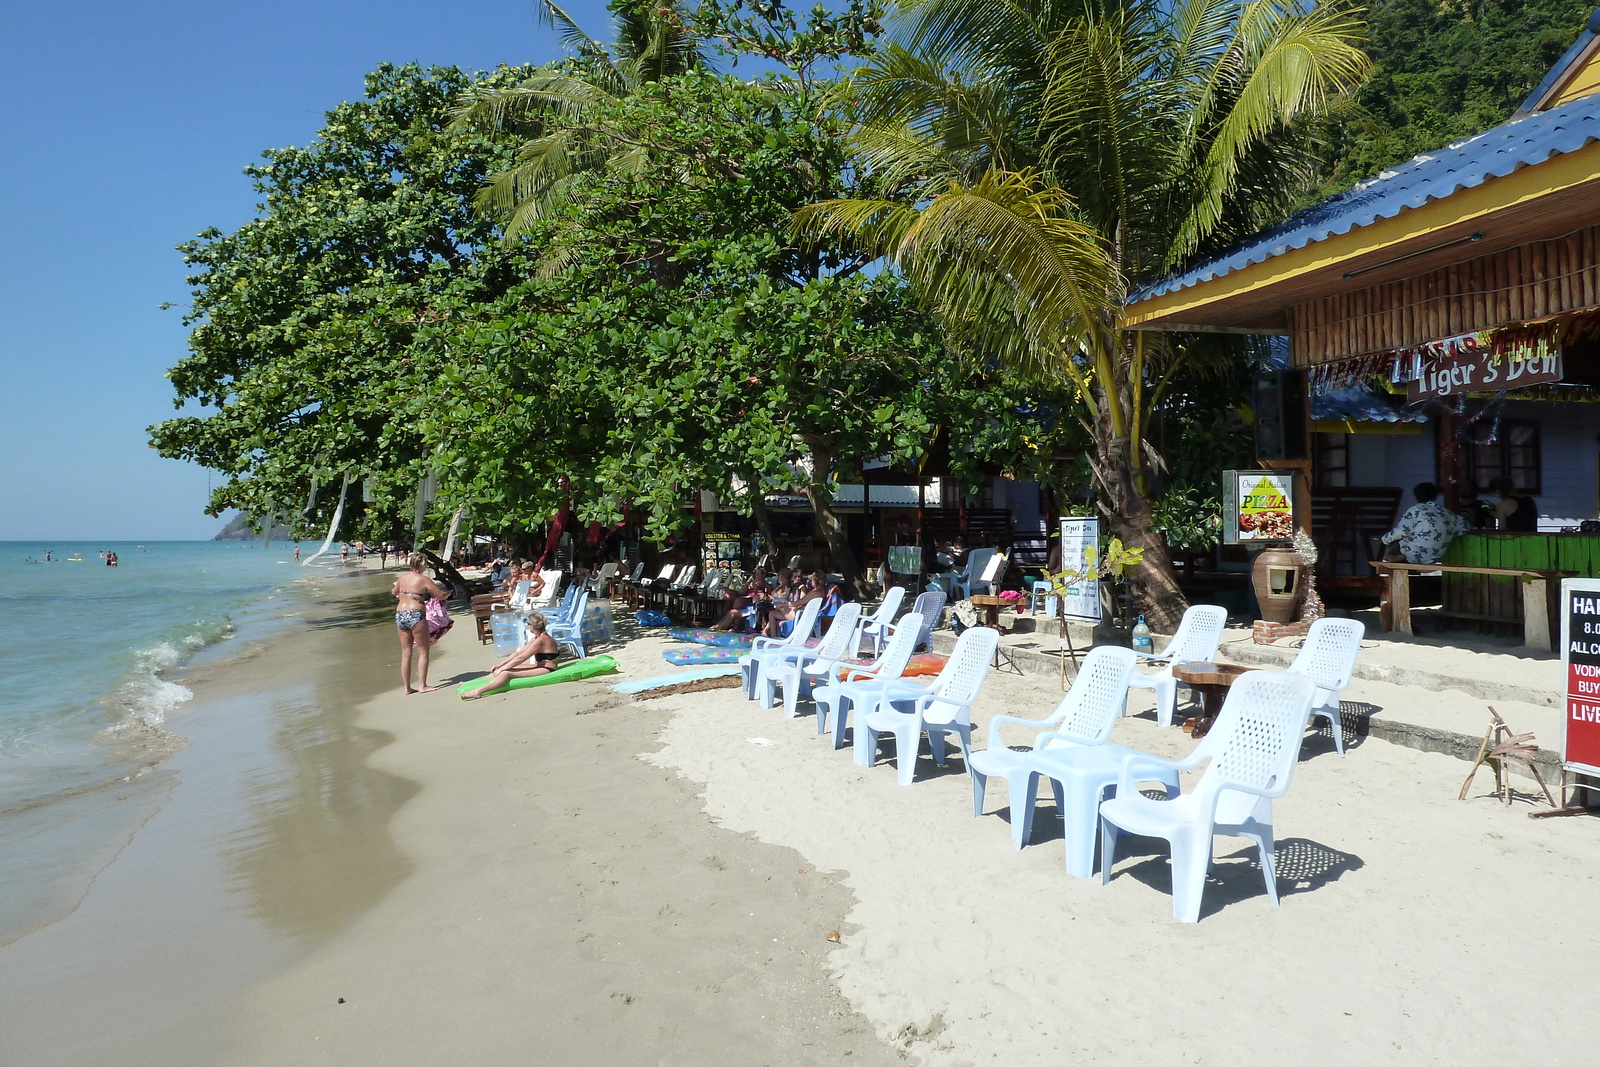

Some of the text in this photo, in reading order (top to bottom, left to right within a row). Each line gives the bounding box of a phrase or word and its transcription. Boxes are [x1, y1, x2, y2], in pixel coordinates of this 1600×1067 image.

[1506, 353, 1556, 381] Den
[1242, 480, 1287, 490] Original Italian
[1241, 494, 1288, 509] PIZZA
[1570, 641, 1590, 654] ALL
[1578, 681, 1600, 694] BUY
